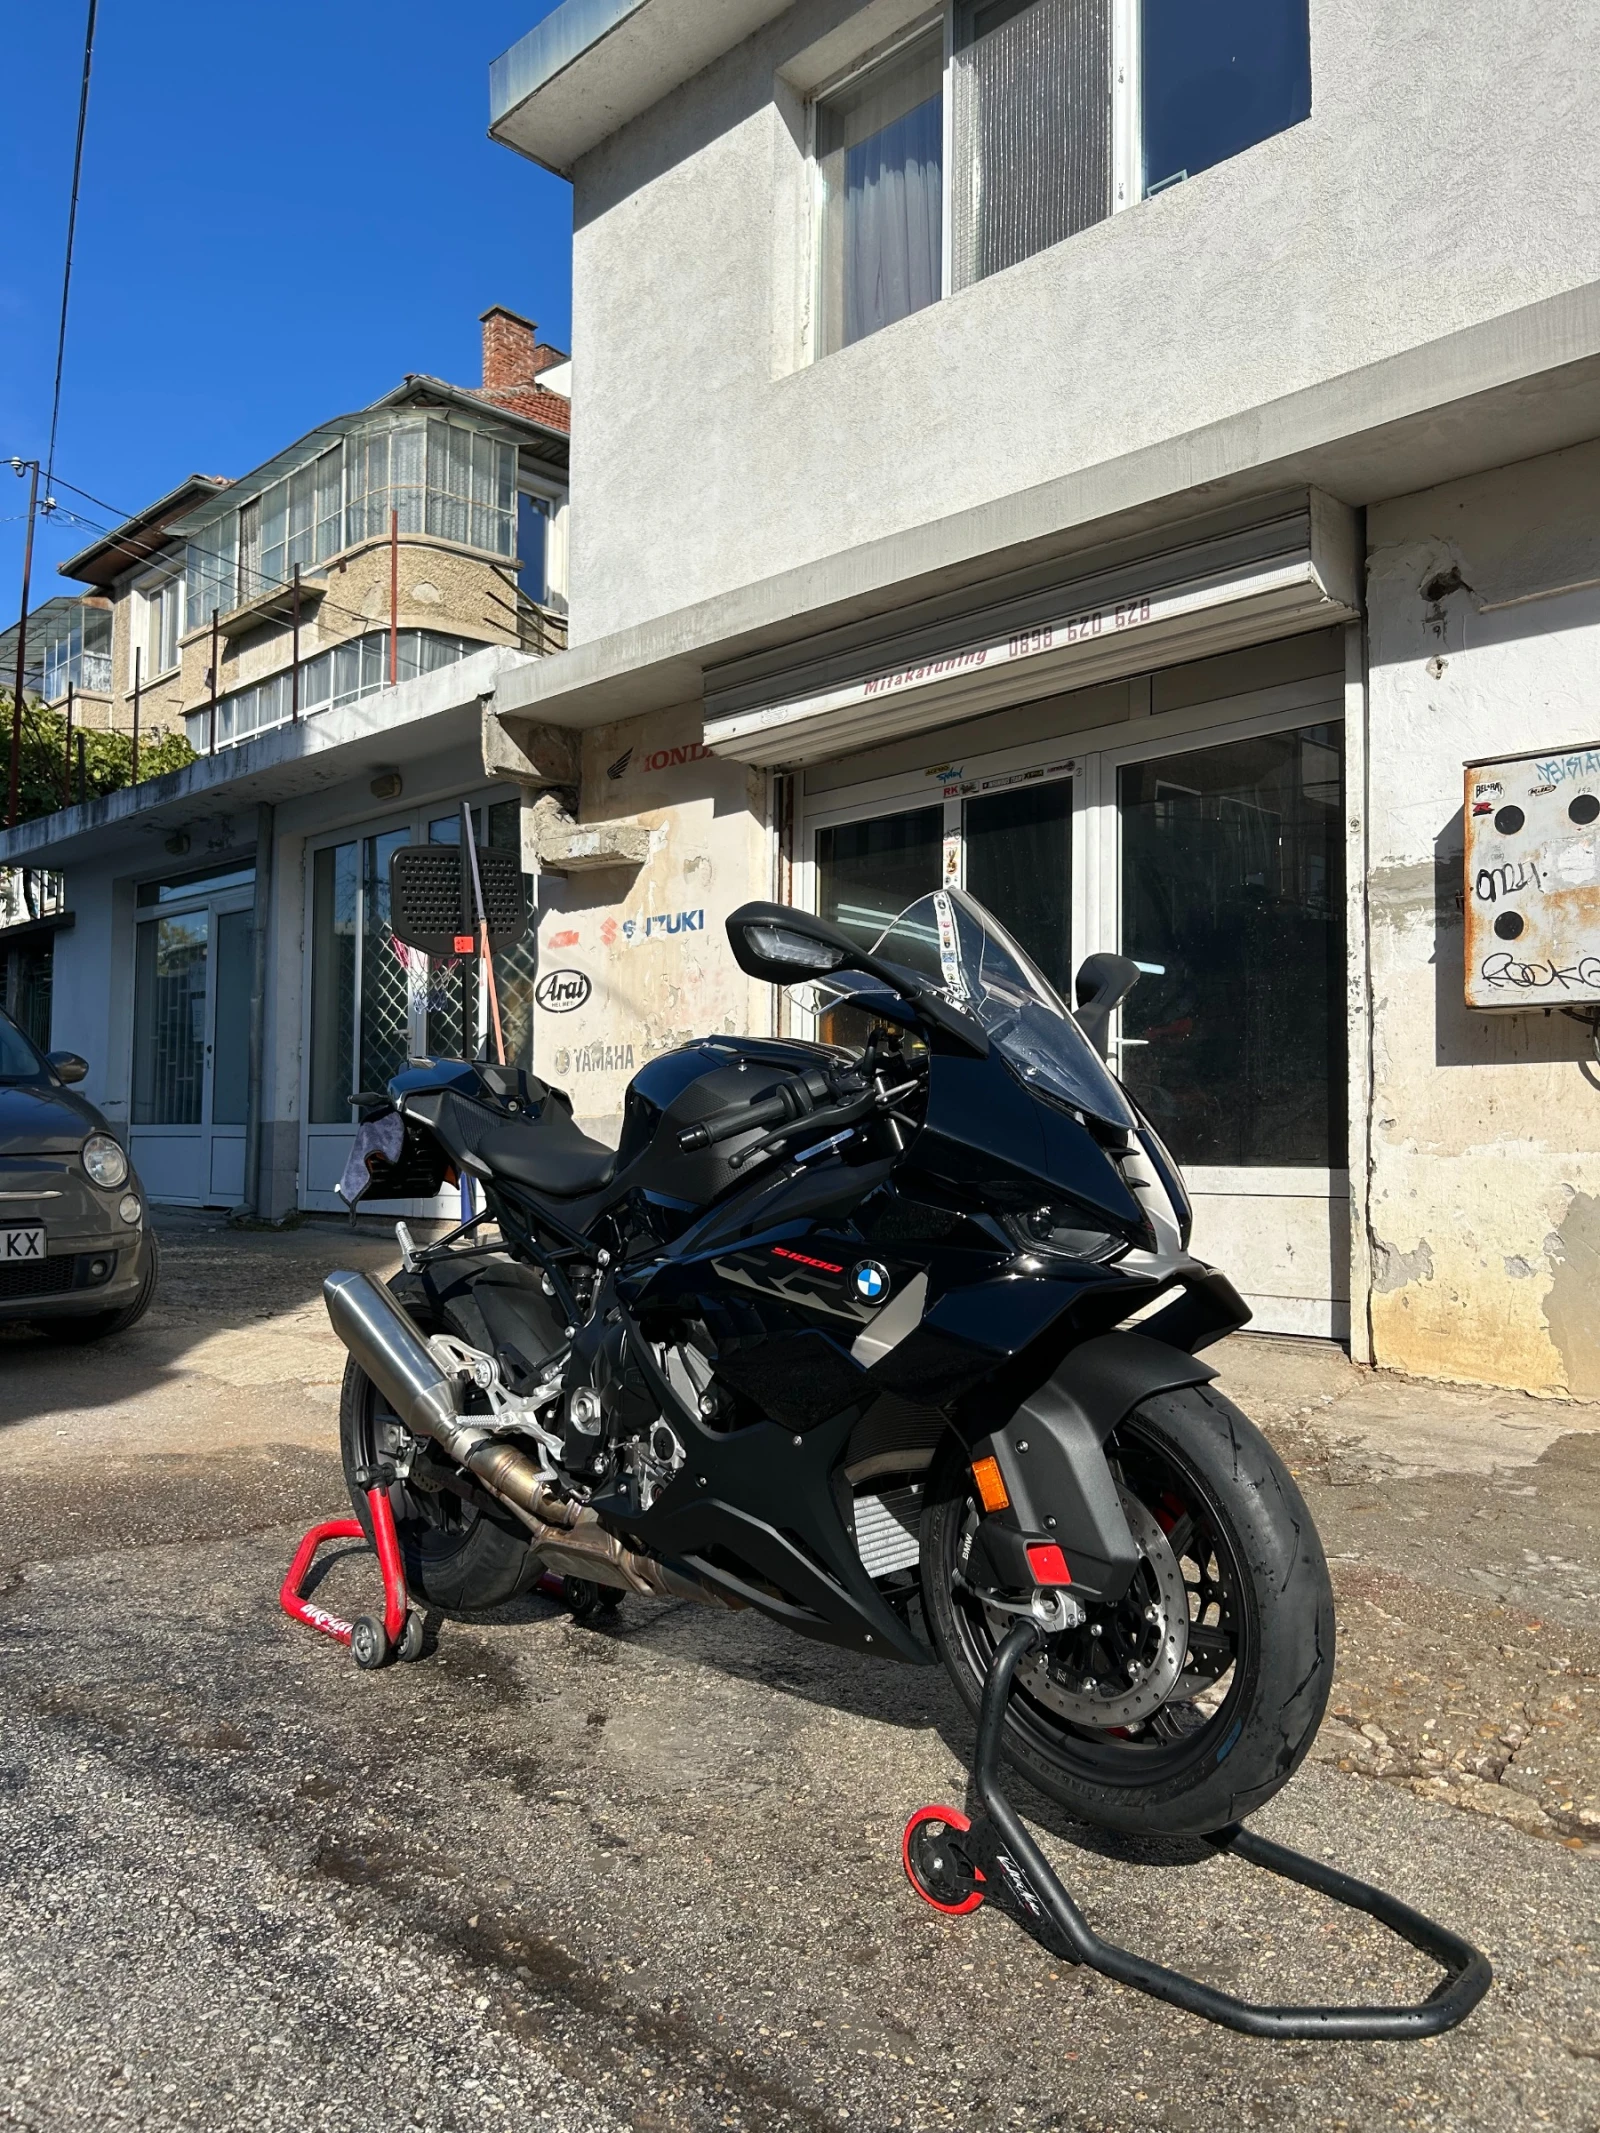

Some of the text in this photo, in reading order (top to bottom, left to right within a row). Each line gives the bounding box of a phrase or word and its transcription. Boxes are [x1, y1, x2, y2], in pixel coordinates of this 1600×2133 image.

[1008, 625, 1053, 658] 0898
[1067, 612, 1102, 642] 620
[1115, 597, 1151, 629] 628
[944, 785, 959, 798] RK
[539, 974, 586, 1002] Arai
[573, 1043, 635, 1073] YAMAHA
[6, 1231, 40, 1257] KX
[770, 1247, 844, 1274] S1000
[855, 1260, 888, 1279] BMW
[961, 1532, 973, 1561] BMW
